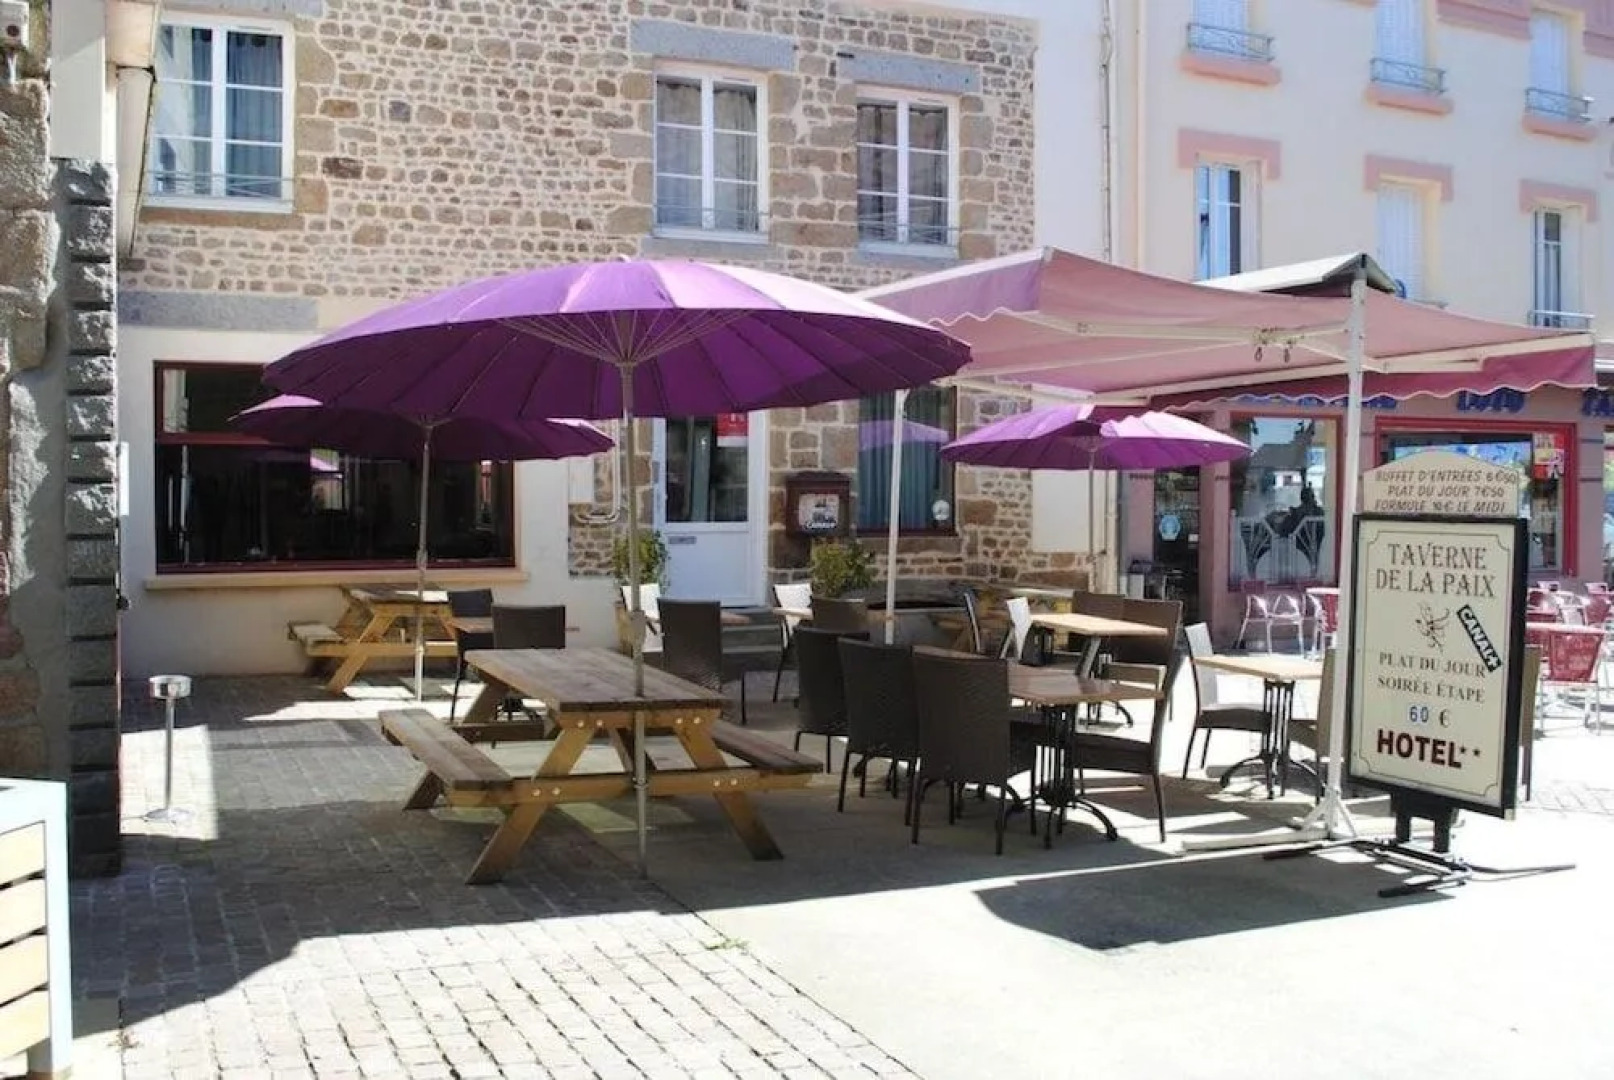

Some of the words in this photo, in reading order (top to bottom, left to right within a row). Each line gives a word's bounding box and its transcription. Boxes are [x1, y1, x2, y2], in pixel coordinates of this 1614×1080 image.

[1387, 485, 1413, 497] PLAT
[1417, 485, 1434, 497] DU
[1437, 485, 1470, 497] JOUR
[1474, 485, 1505, 497] 7€50
[1375, 499, 1427, 511] FORMULE
[1457, 501, 1470, 512] LE
[1473, 501, 1506, 513] MIDI
[1387, 542, 1487, 570] TAVERNE
[1376, 567, 1401, 590] DE
[1408, 570, 1434, 594] LA
[1442, 572, 1496, 598] PAIX
[1379, 651, 1415, 669] PLAT
[1419, 656, 1438, 671] DU
[1443, 660, 1486, 678] JOUR
[1377, 676, 1432, 695] SOIRÉE
[1436, 681, 1486, 703] ÉTAPE
[1409, 706, 1429, 723] 60
[1439, 708, 1451, 728] €
